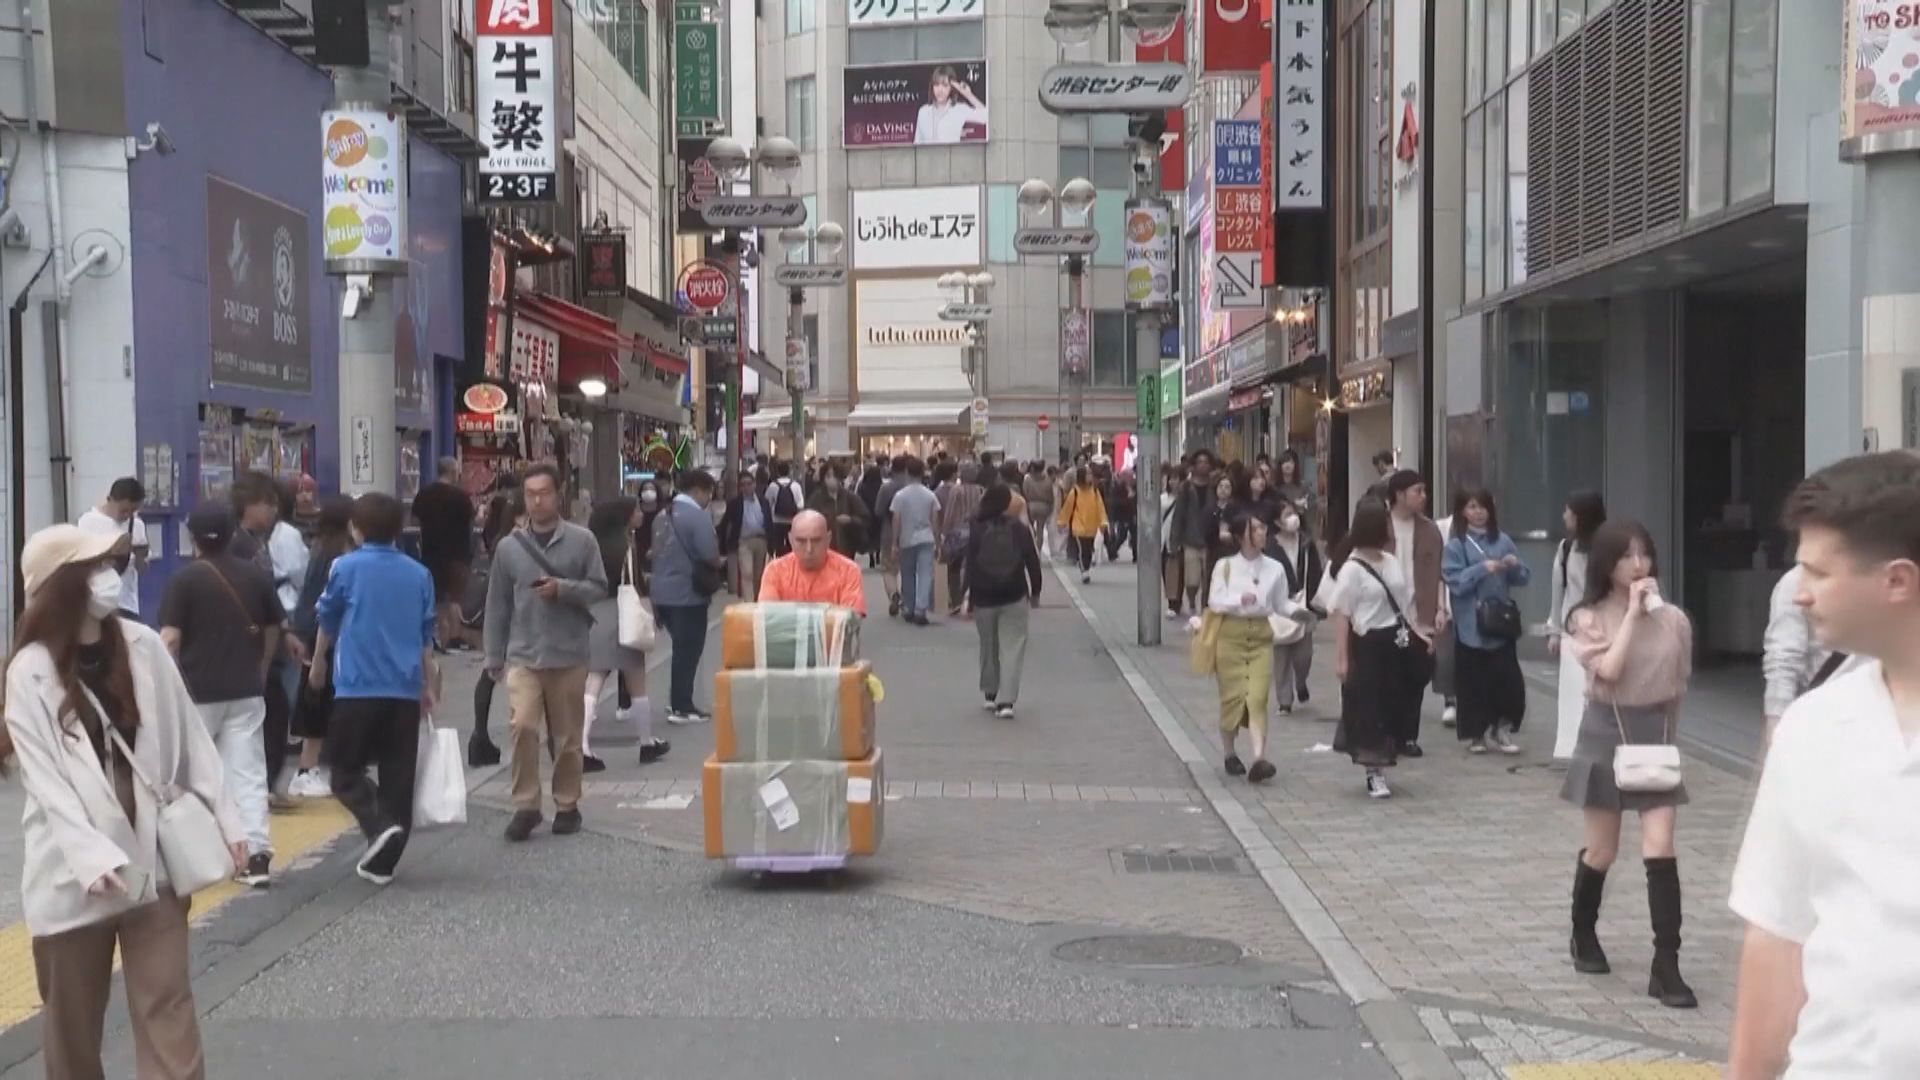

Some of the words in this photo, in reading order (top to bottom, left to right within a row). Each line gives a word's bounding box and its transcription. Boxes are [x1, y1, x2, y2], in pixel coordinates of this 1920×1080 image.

[1048, 74, 1183, 95] 渋谷センター街
[491, 41, 544, 151] 牛繁
[1235, 124, 1261, 147] 渋谷
[324, 174, 394, 195] Welcome
[1216, 168, 1261, 182] クリニック
[707, 203, 799, 218] 渋谷センター街
[1235, 192, 1262, 214] 渋谷
[1216, 217, 1262, 232] コンタクト
[1018, 234, 1095, 246] 渋谷センター街
[1227, 234, 1254, 249] レンズ
[689, 279, 725, 298] 消火栓
[273, 310, 297, 345] BOSS
